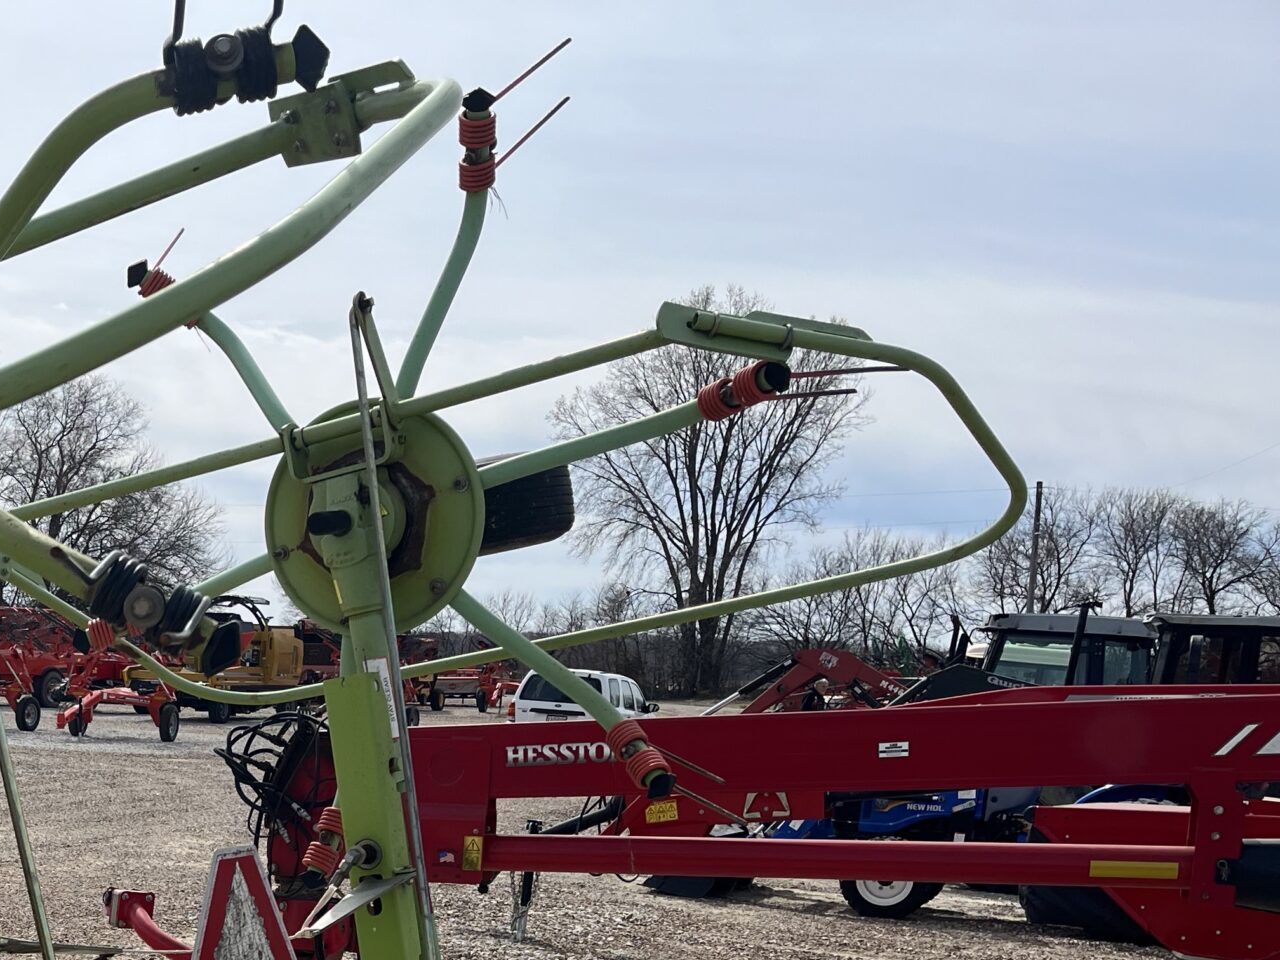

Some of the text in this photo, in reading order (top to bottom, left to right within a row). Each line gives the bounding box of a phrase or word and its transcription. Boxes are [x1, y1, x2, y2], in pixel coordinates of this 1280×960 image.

[383, 676, 396, 722] STAY CLEAR
[505, 742, 615, 768] HESSTO
[906, 803, 926, 811] NEW
